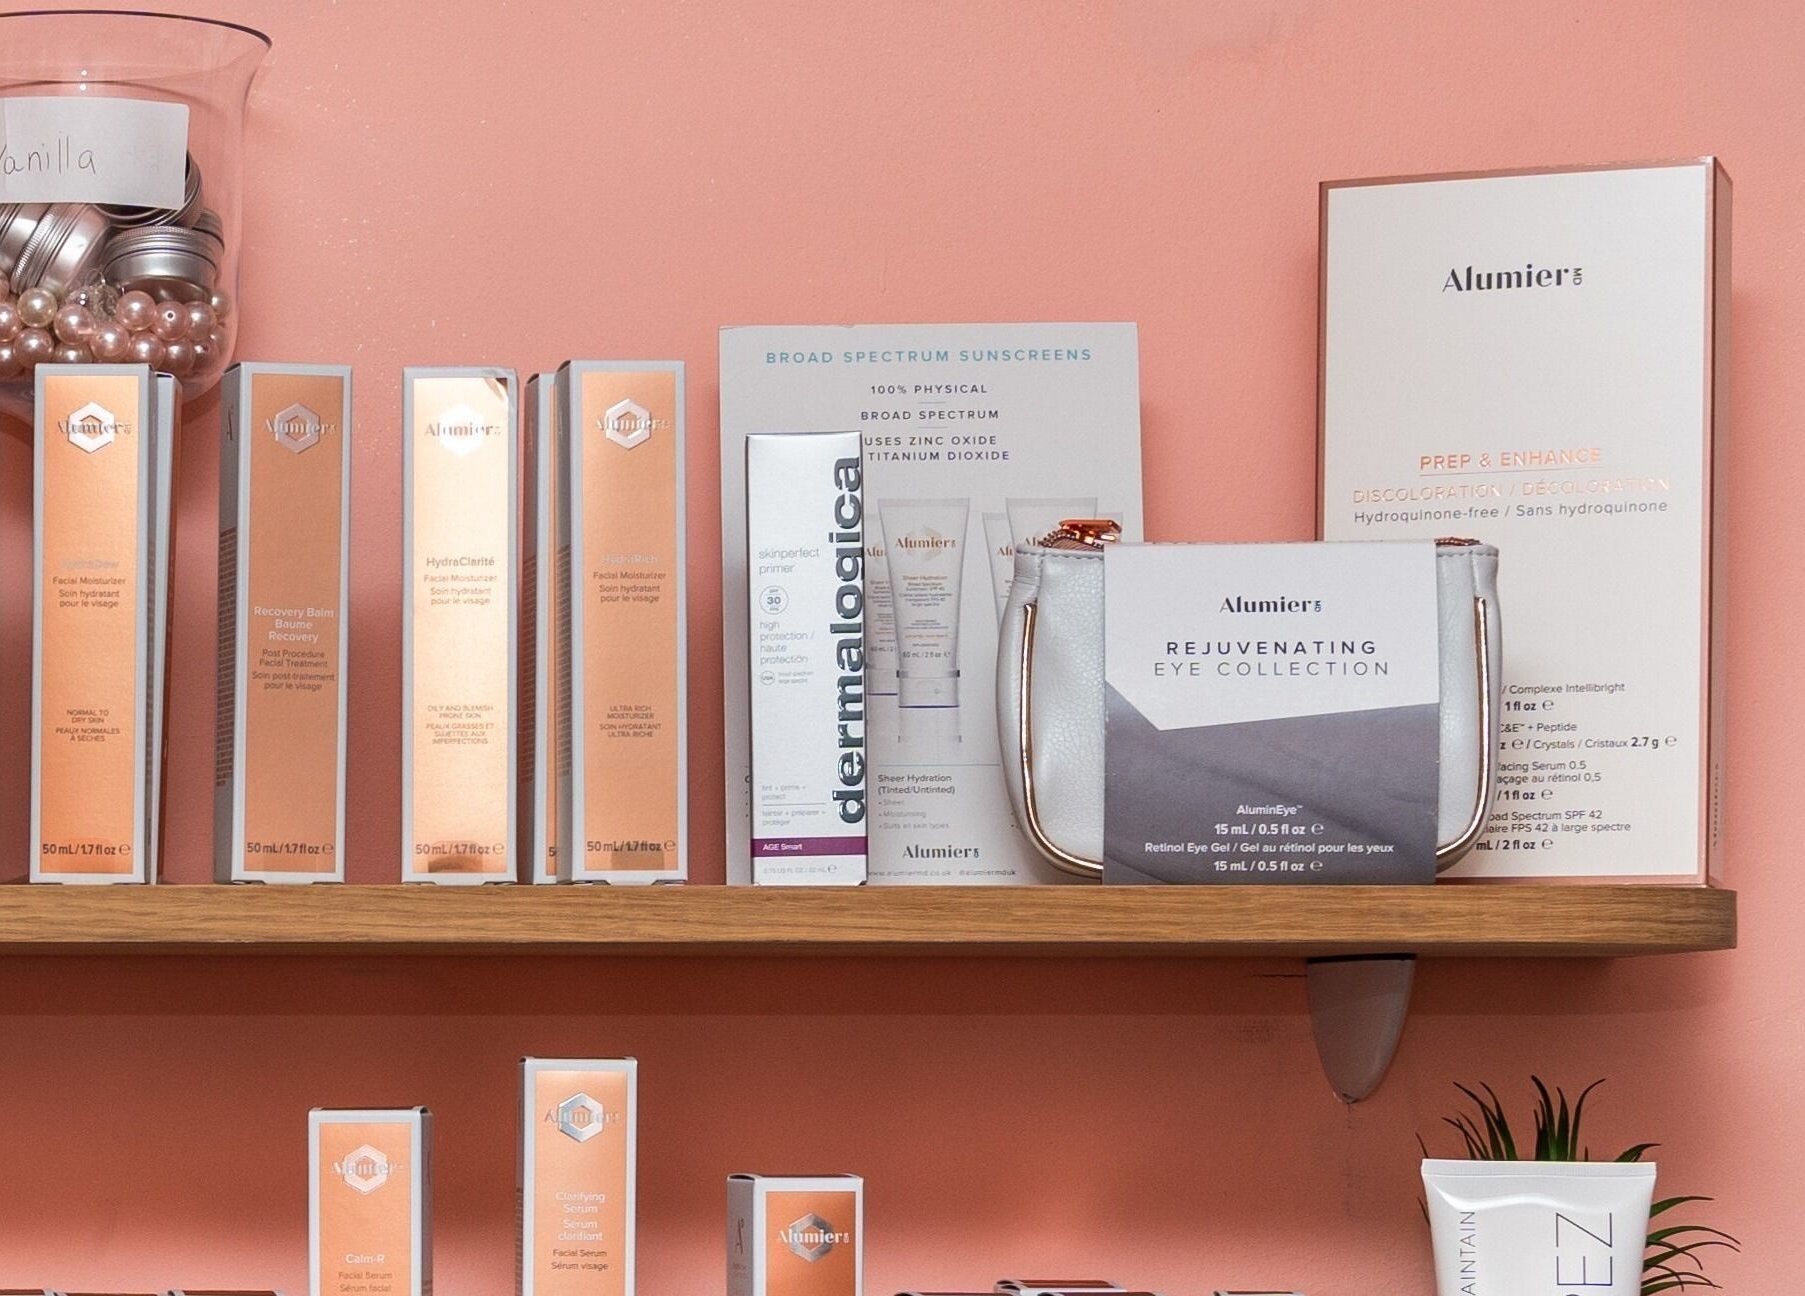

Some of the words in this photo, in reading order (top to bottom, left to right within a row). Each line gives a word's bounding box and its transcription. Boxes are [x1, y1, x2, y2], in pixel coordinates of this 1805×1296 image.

[766, 352, 833, 363] BROAD
[843, 351, 949, 362] SPECTRUM
[960, 349, 1092, 361] SUNSCREENS
[871, 386, 906, 394] 100%
[914, 384, 987, 394] PHYSICAL
[861, 411, 911, 421] BROAD
[919, 410, 999, 420] SPECTRUM
[865, 437, 901, 446] USES
[909, 436, 943, 445] ZINC
[951, 436, 996, 445] OXIDE
[868, 452, 939, 461] TITANIUM
[948, 451, 1009, 460] DIOXIDE
[1420, 455, 1471, 470] PREP
[1480, 453, 1492, 468] &
[1500, 448, 1602, 466] ENHANCE
[1354, 484, 1501, 503] DISCOLORATION
[1522, 479, 1670, 496] DÉCOLORATION
[1354, 507, 1499, 526] Hydroquinone-free
[1516, 505, 1552, 516] Sans
[1559, 501, 1668, 518] hydroquinone
[759, 548, 819, 560] skinperfect
[759, 564, 794, 575] primer
[767, 597, 781, 605] 30
[829, 457, 865, 824] dermalogica
[1166, 641, 1376, 654] REJUVENATING
[1155, 662, 1201, 676] EYE
[1217, 662, 1389, 676] COLLECTION
[1509, 685, 1562, 695] Complexe
[1214, 824, 1228, 834] 15
[1231, 824, 1248, 834] mL
[1259, 824, 1278, 834] 0.5
[1292, 826, 1306, 834] oz
[1145, 843, 1184, 852] Retinol
[1187, 844, 1208, 854] Eye
[1211, 843, 1230, 852] Gel
[1240, 843, 1260, 852] Gel
[1280, 842, 1315, 852] rétinol
[1318, 844, 1344, 854] pour
[1347, 843, 1363, 852] les
[1366, 844, 1393, 854] yeux
